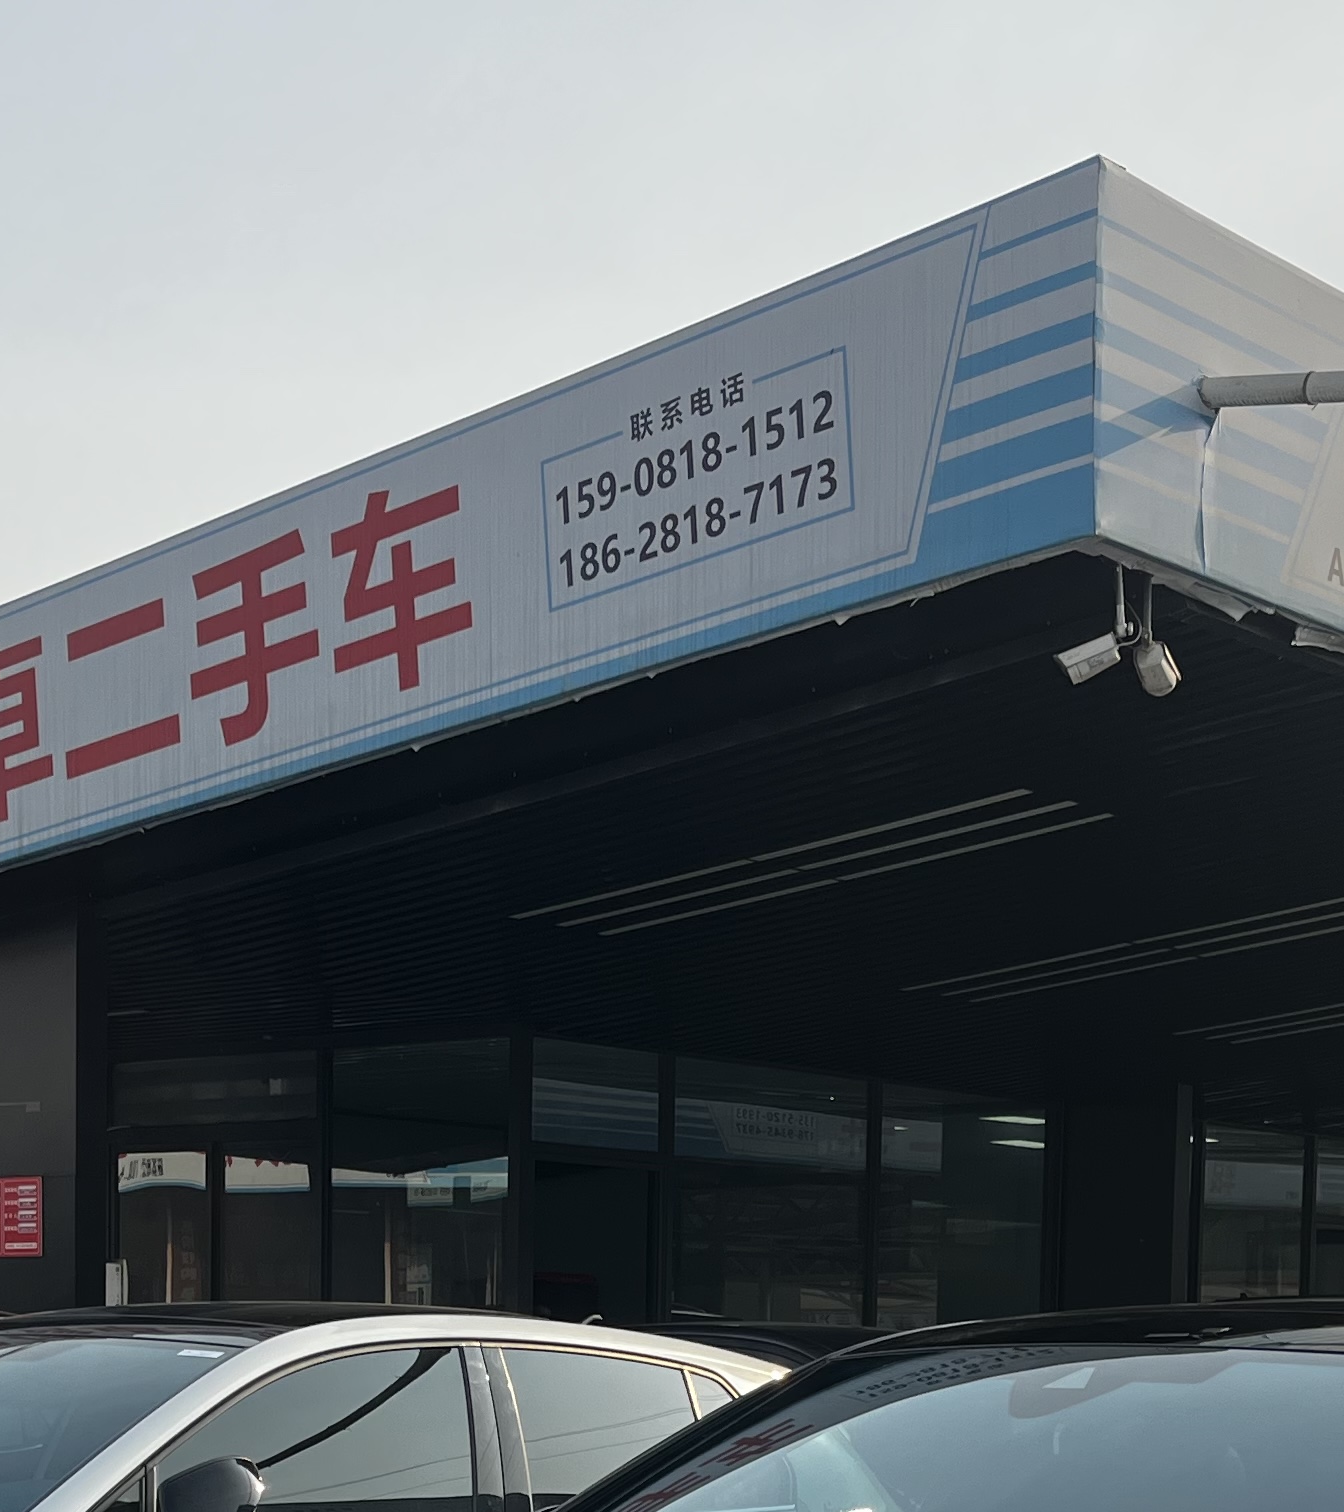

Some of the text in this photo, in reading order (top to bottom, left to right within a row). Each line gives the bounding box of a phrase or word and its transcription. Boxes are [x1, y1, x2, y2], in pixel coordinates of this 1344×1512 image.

[556, 390, 834, 525] 159-0818-1512
[630, 372, 744, 442] 联系电话
[559, 457, 838, 588] 186-2818-7173
